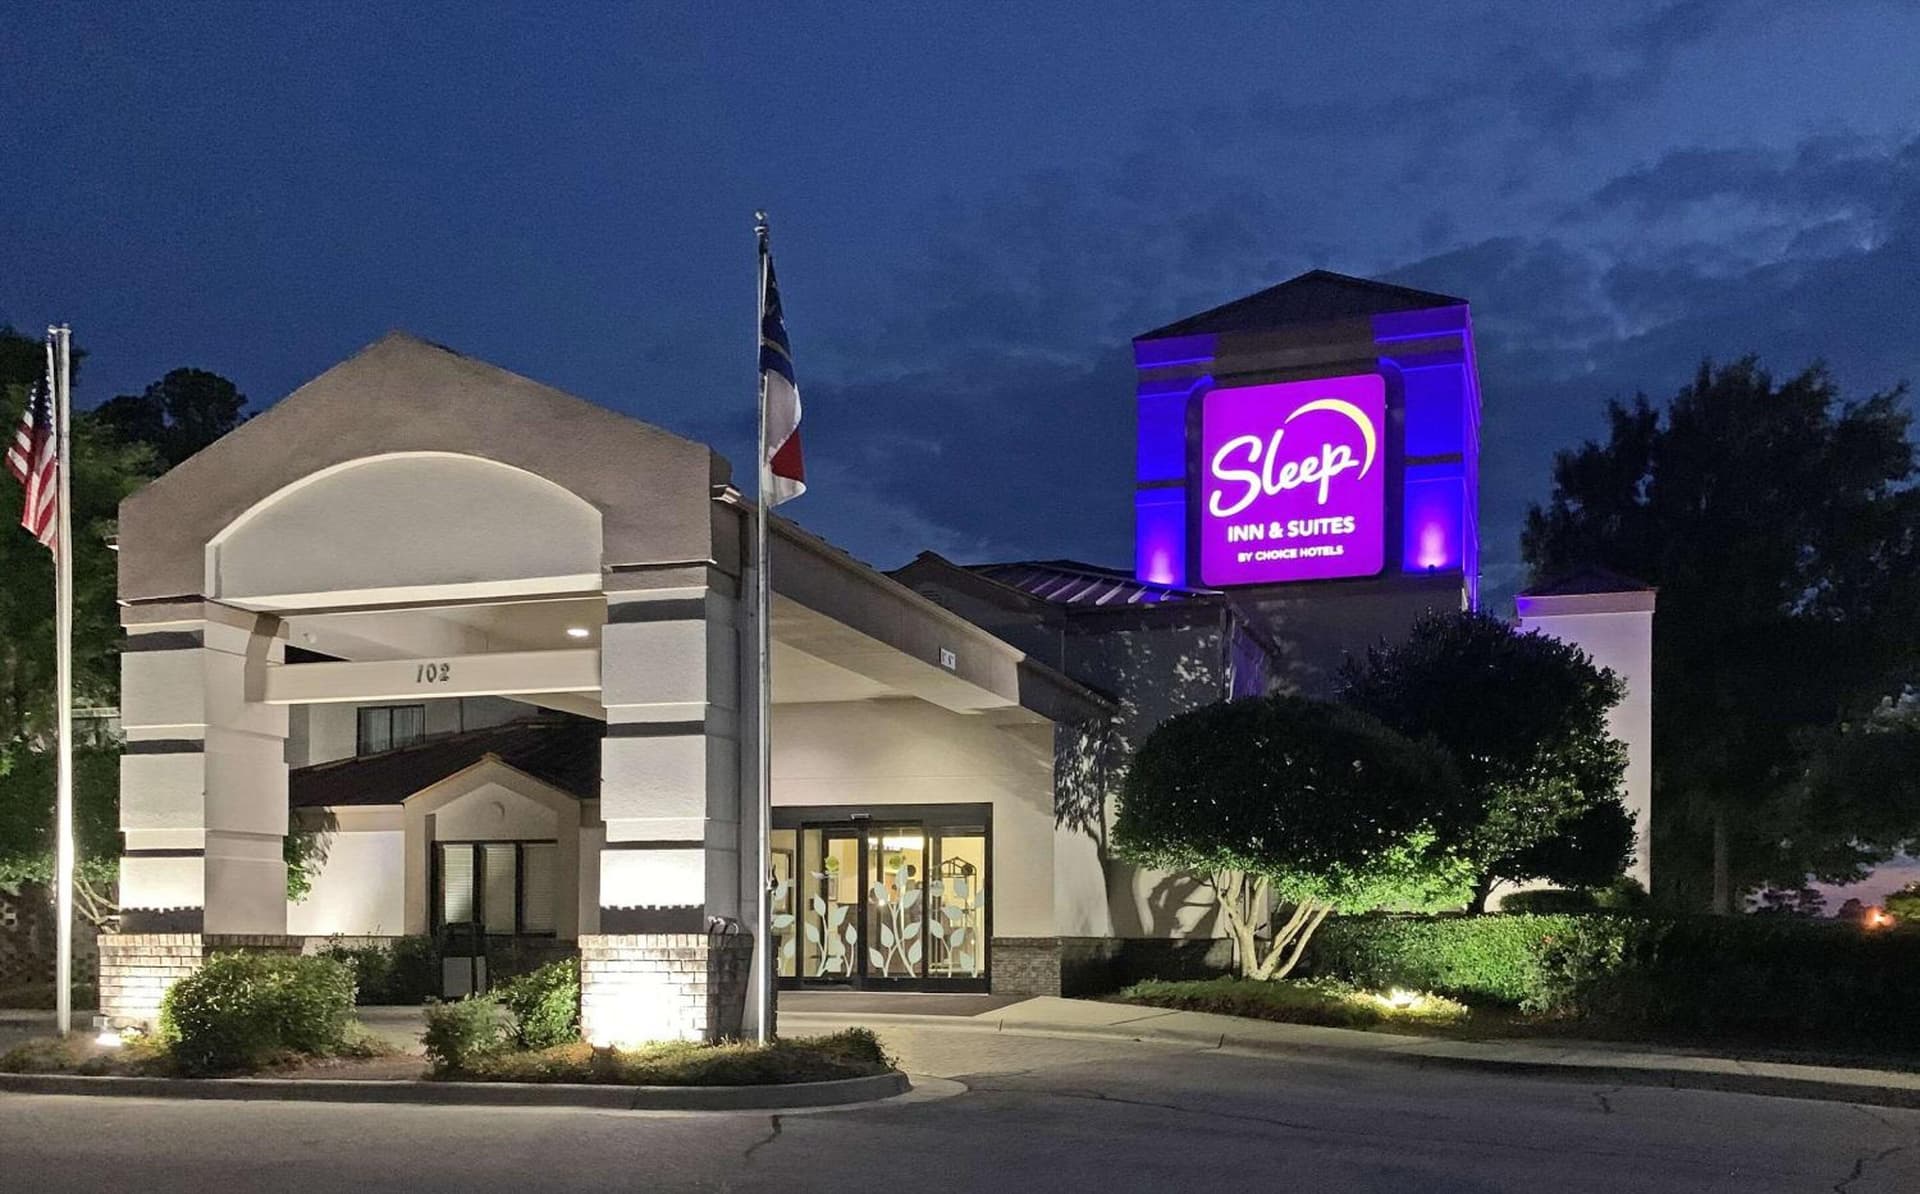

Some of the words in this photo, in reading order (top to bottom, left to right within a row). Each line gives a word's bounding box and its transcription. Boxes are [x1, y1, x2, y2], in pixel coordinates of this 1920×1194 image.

[1209, 429, 1360, 518] Sleep
[1227, 523, 1264, 542] INN
[1268, 522, 1284, 539] &
[1287, 516, 1356, 537] SUITES
[1237, 551, 1253, 563] BY
[1255, 548, 1298, 561] CHOICE
[1300, 545, 1344, 559] HOTELS
[416, 663, 450, 683] 102
